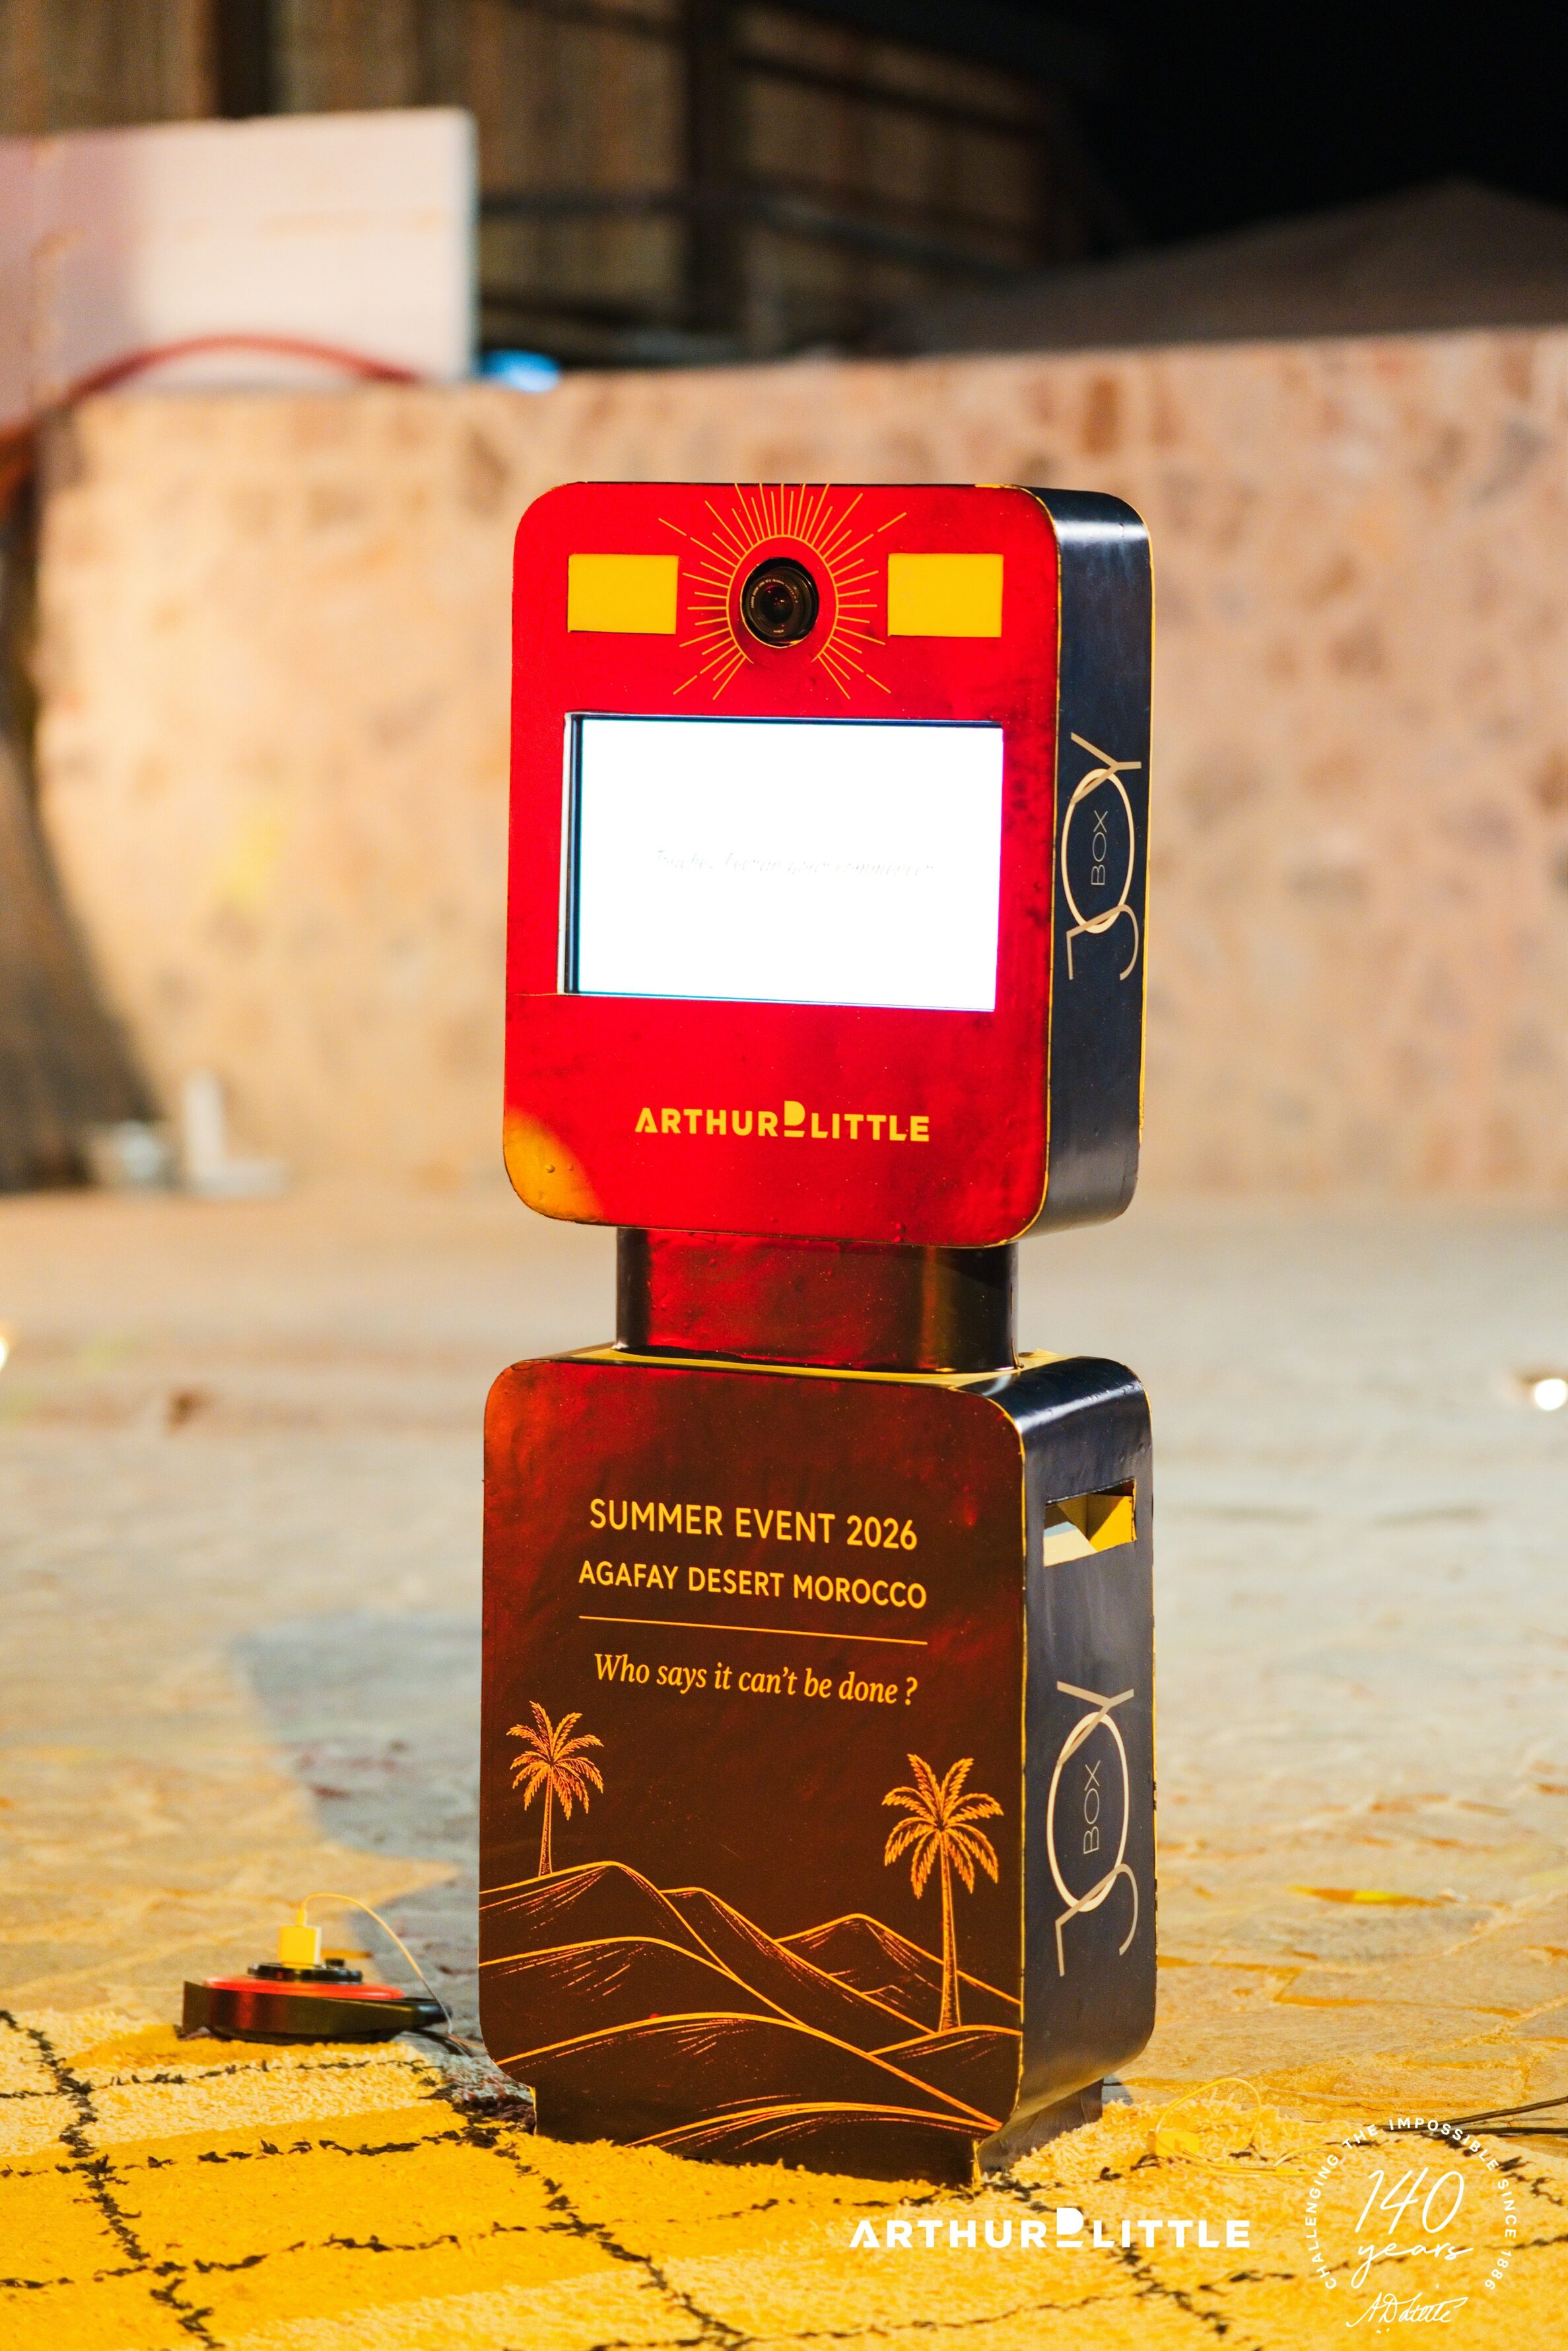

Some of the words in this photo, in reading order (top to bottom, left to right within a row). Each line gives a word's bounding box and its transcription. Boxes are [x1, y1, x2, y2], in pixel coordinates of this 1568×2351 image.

[1091, 810, 1108, 885] BOX
[590, 1498, 724, 1536] SUMMER
[735, 1507, 835, 1543] EVENT
[846, 1515, 917, 1550] 2026
[578, 1560, 679, 1590] AGAFAY
[688, 1566, 784, 1597] DESERT
[794, 1574, 927, 1609] MOROCCO
[595, 1653, 650, 1684] Who
[656, 1664, 707, 1695] says
[714, 1662, 732, 1690] it
[738, 1667, 797, 1695] can’t
[804, 1667, 831, 1698] be
[838, 1672, 898, 1704] done
[1083, 1760, 1101, 1854] BOX
